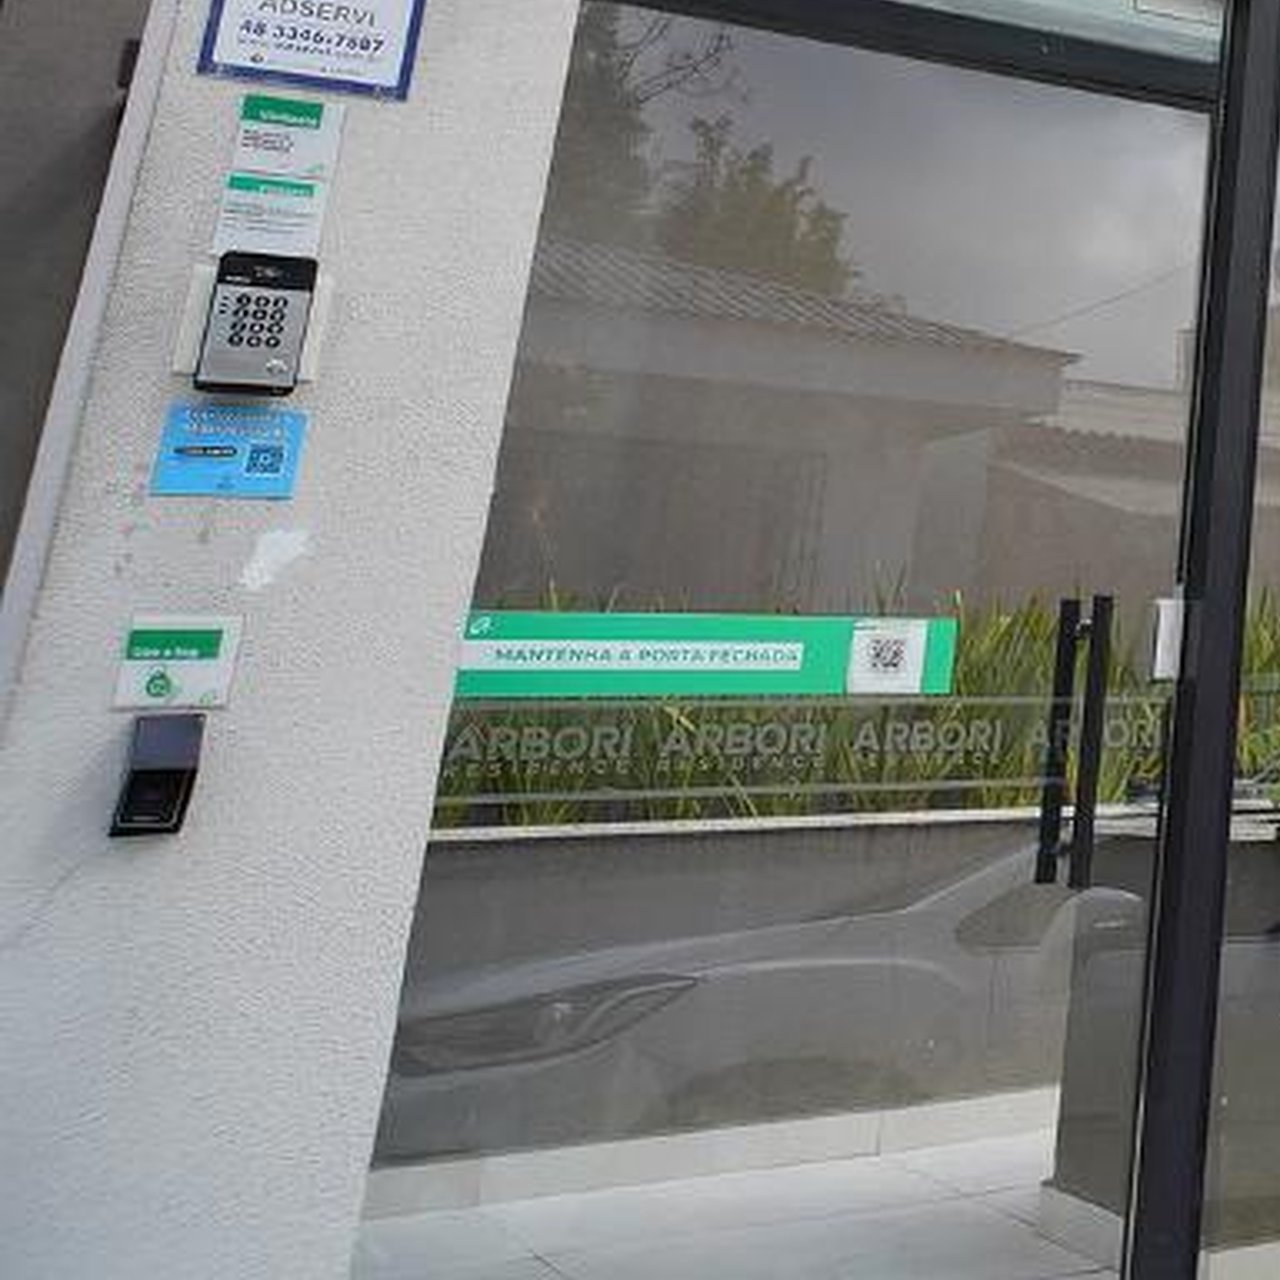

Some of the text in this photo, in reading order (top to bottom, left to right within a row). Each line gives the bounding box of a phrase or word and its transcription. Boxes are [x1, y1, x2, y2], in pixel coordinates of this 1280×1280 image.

[495, 646, 612, 662] MANTENHA
[638, 648, 704, 663] PORTA
[709, 648, 799, 663] FECHADA
[448, 719, 1163, 764] ARBORI ARBORI ARBORI ARORI
